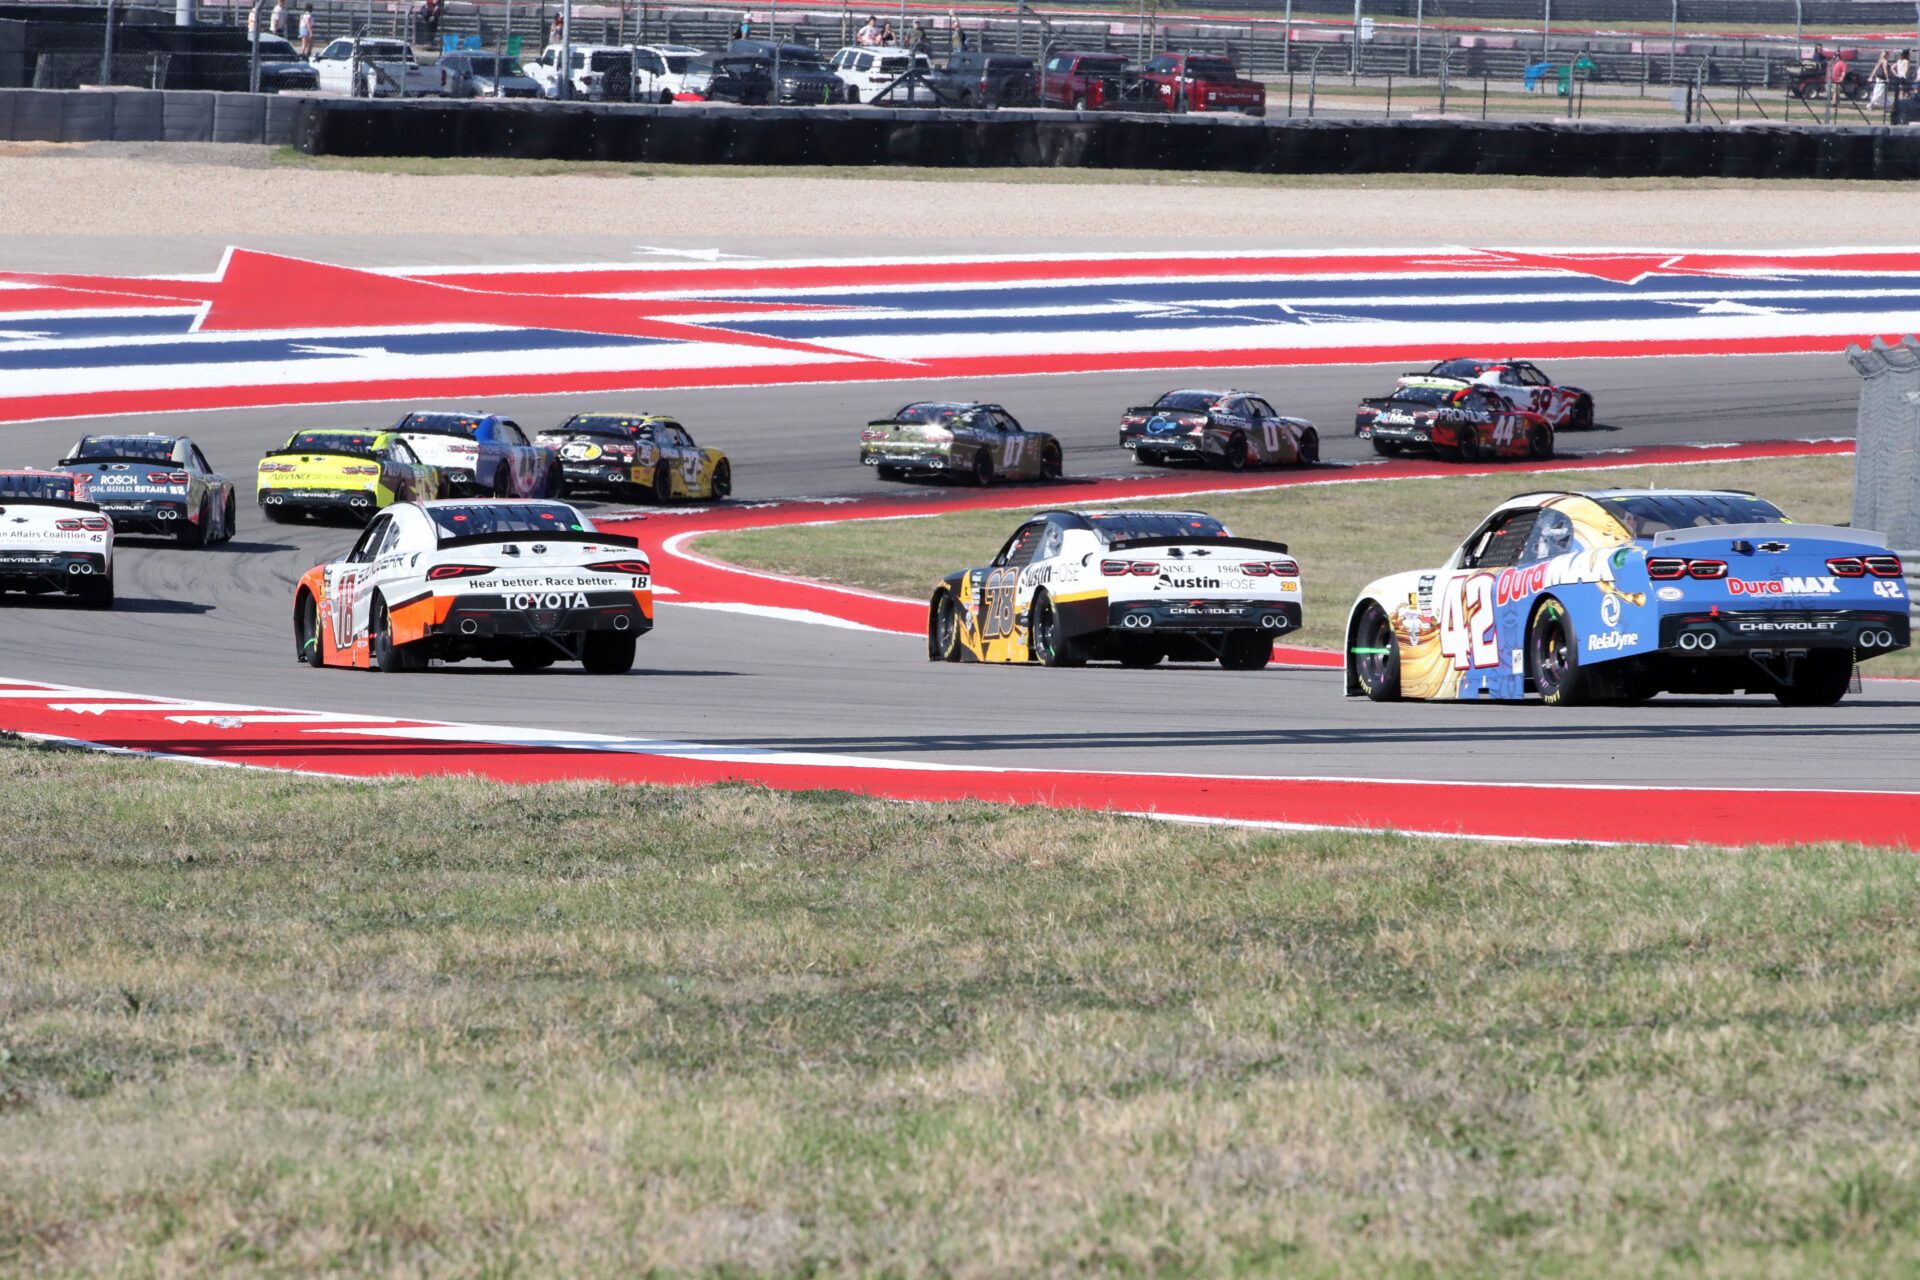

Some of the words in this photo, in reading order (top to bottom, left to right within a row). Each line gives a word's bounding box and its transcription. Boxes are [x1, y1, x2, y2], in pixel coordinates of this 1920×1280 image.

[1493, 415, 1515, 446] 44
[1003, 435, 1025, 468] 07
[10, 530, 41, 539] Affairs
[44, 530, 87, 540] Coalition
[90, 534, 103, 543] 45
[1163, 565, 1195, 573] SINCE
[1217, 565, 1240, 573] 1966
[469, 580, 497, 589] Hear
[501, 577, 543, 588] better.
[545, 577, 574, 587] Race
[577, 576, 618, 587] better.
[631, 577, 648, 589] 18
[1281, 581, 1297, 592] 28
[1873, 580, 1905, 599] 42
[501, 592, 590, 610] TOYOTA
[1440, 572, 1500, 671] 42
[1739, 621, 1838, 631] CHEVROLET
[1588, 631, 1639, 651] RelaDyne
